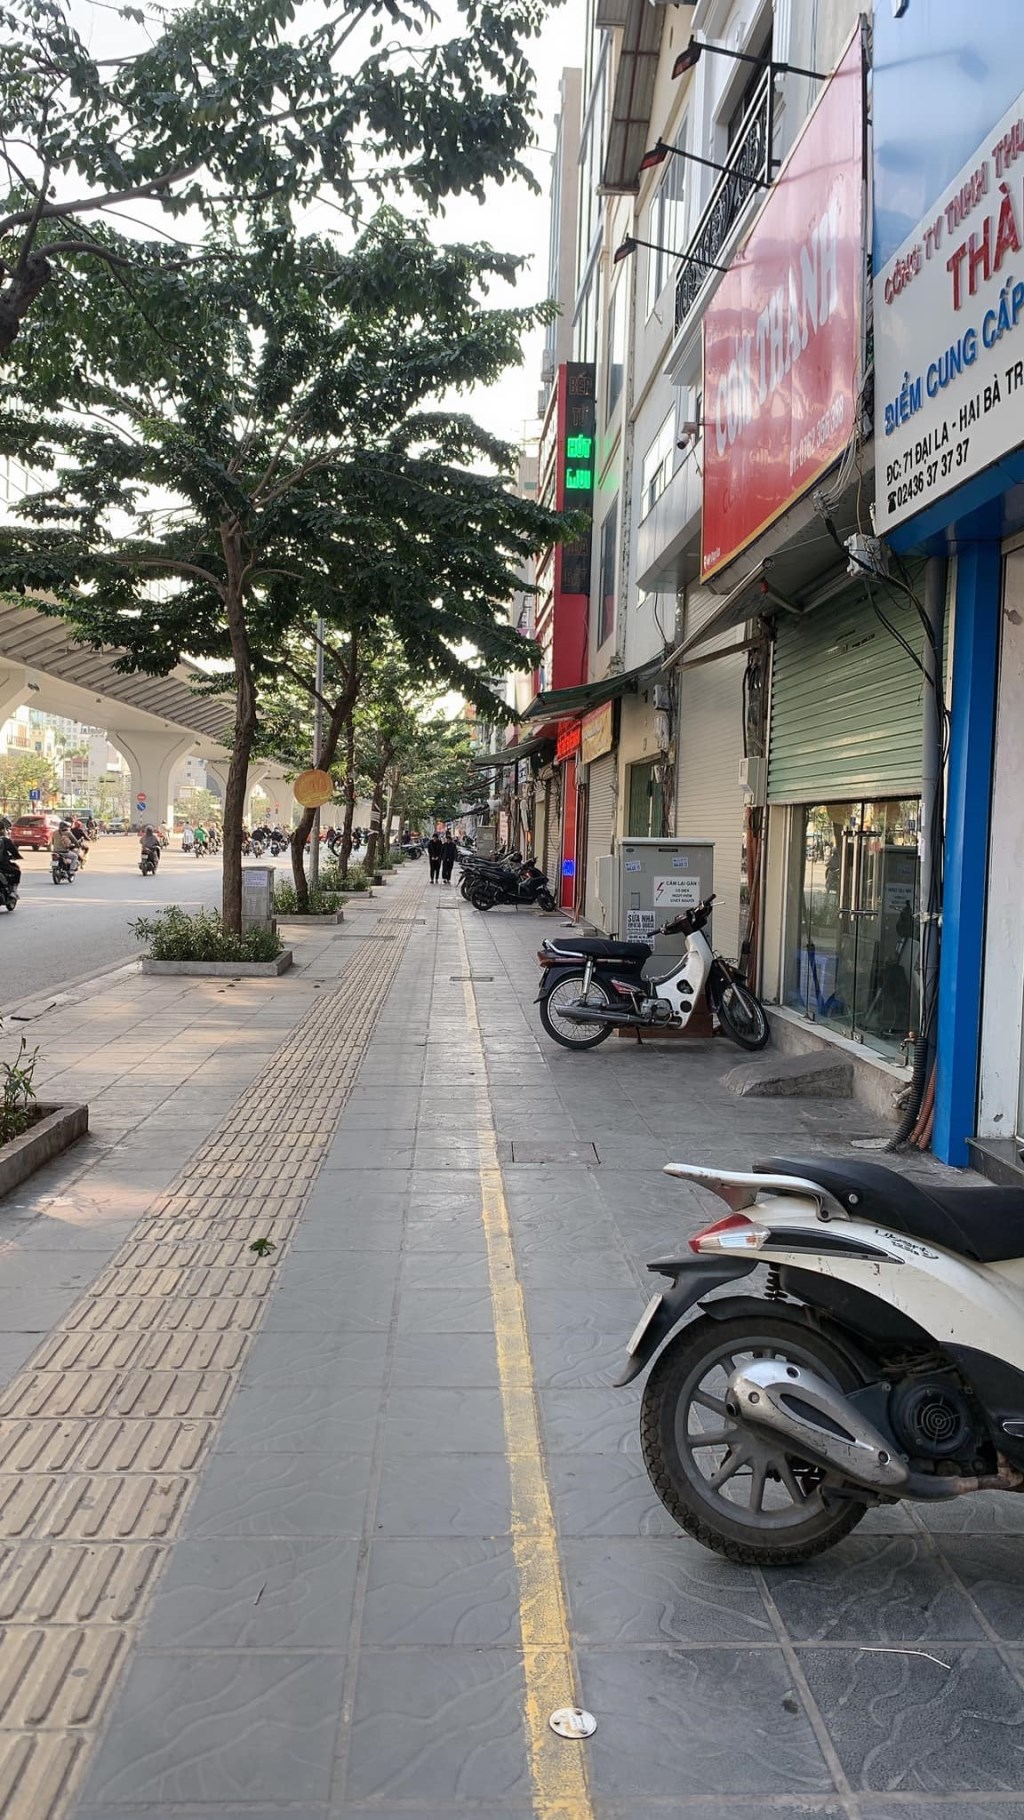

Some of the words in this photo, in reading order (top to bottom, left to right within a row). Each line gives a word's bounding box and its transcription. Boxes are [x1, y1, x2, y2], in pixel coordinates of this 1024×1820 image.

[884, 244, 922, 305] CÔNG
[922, 215, 945, 260] TY
[944, 161, 988, 235] TNHH
[946, 181, 1024, 311] THÀ
[884, 371, 924, 436] ĐIỂM
[926, 327, 978, 399] CUNG
[982, 275, 1024, 349] CẤP
[886, 464, 902, 487] ĐC:
[903, 448, 912, 474] 71
[915, 438, 932, 466] ĐẠI
[934, 421, 949, 451] LA
[959, 394, 980, 432] HAI
[984, 374, 1001, 413] BÀ
[896, 471, 924, 508] 02436
[926, 463, 938, 490] 37
[941, 448, 954, 477] 37
[956, 437, 970, 467] 37
